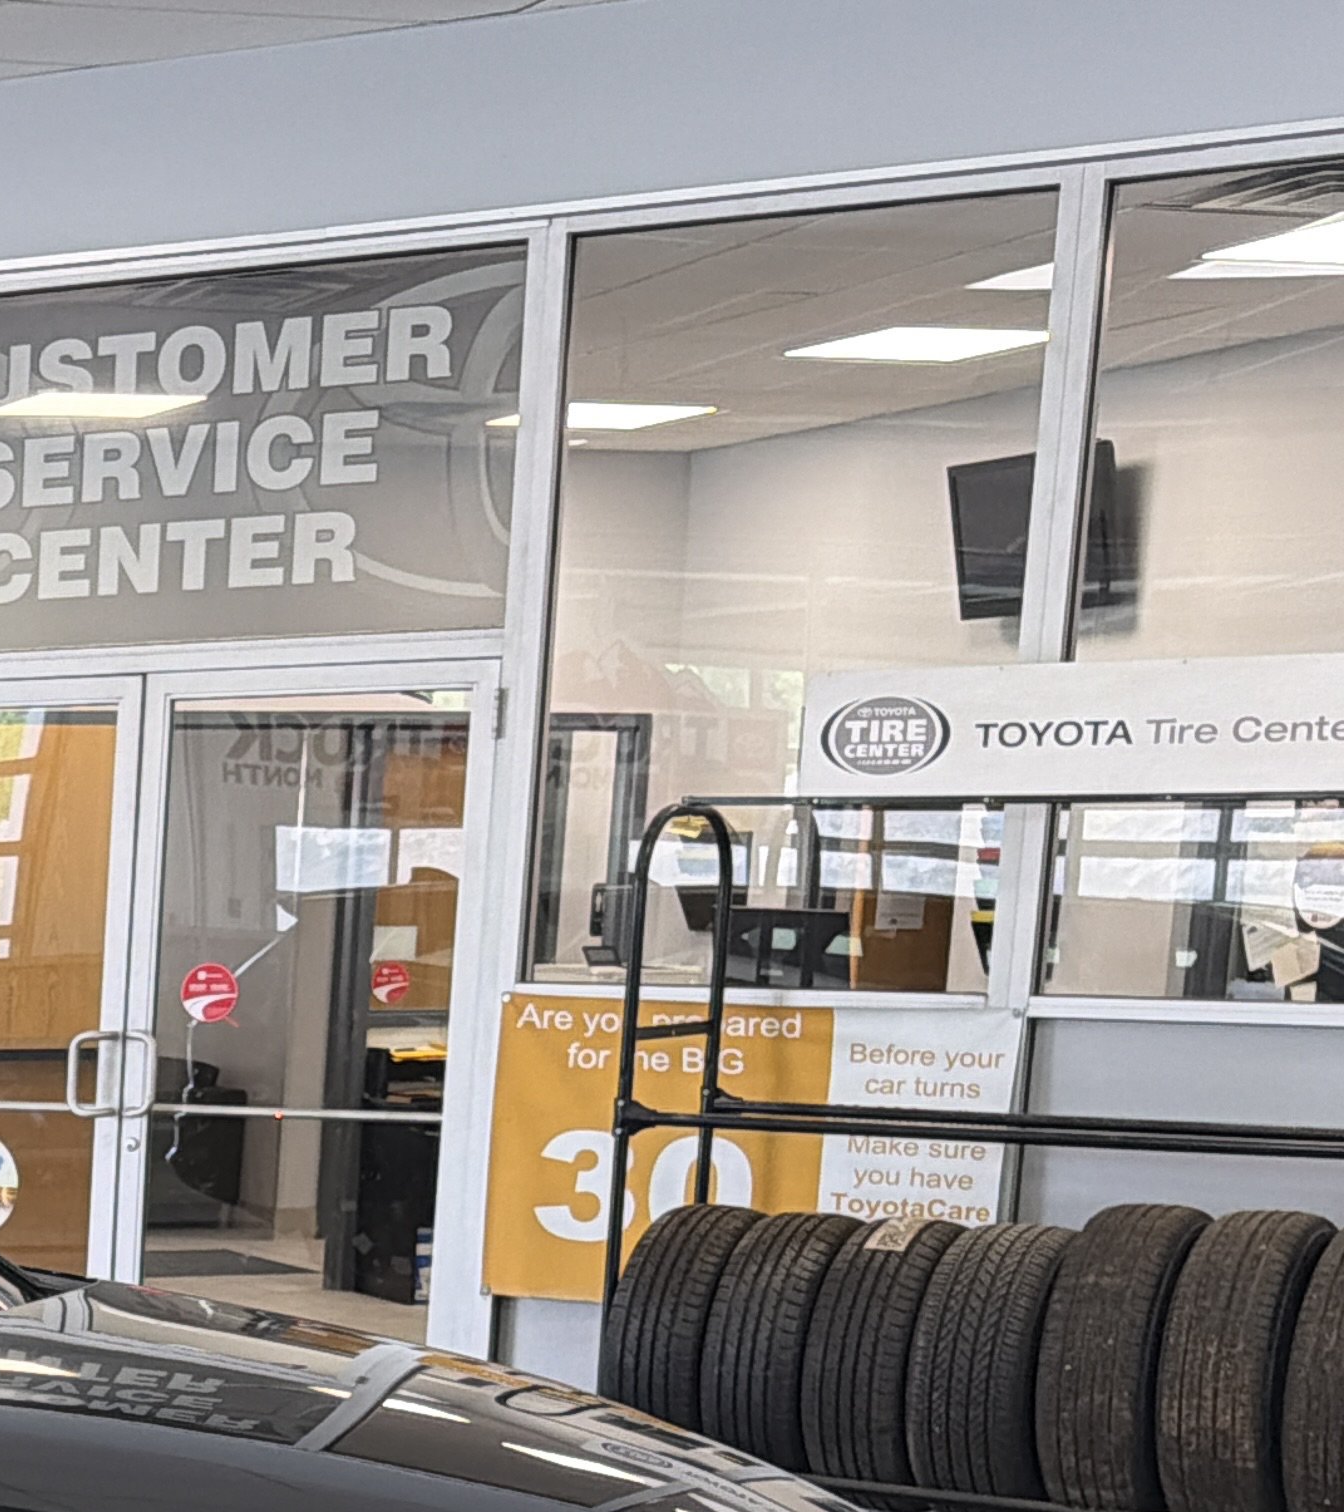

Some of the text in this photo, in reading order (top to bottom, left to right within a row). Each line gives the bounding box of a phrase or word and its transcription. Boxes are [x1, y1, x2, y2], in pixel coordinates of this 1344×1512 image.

[874, 707, 917, 716] TOYOTA
[844, 718, 928, 743] TIRE
[975, 720, 1133, 748] TOYOTA
[1146, 717, 1219, 745] Tire
[843, 743, 925, 758] CENTER
[515, 1003, 573, 1029] Are
[582, 1011, 623, 1037] yo
[567, 1042, 611, 1069] for
[681, 1046, 745, 1076] BG
[850, 1042, 1005, 1072] Before your
[864, 1077, 981, 1099] car turns
[847, 1135, 987, 1161] Make sure
[532, 1129, 753, 1243] 30
[853, 1166, 974, 1190] you have
[830, 1192, 991, 1222] ToyotaCare
